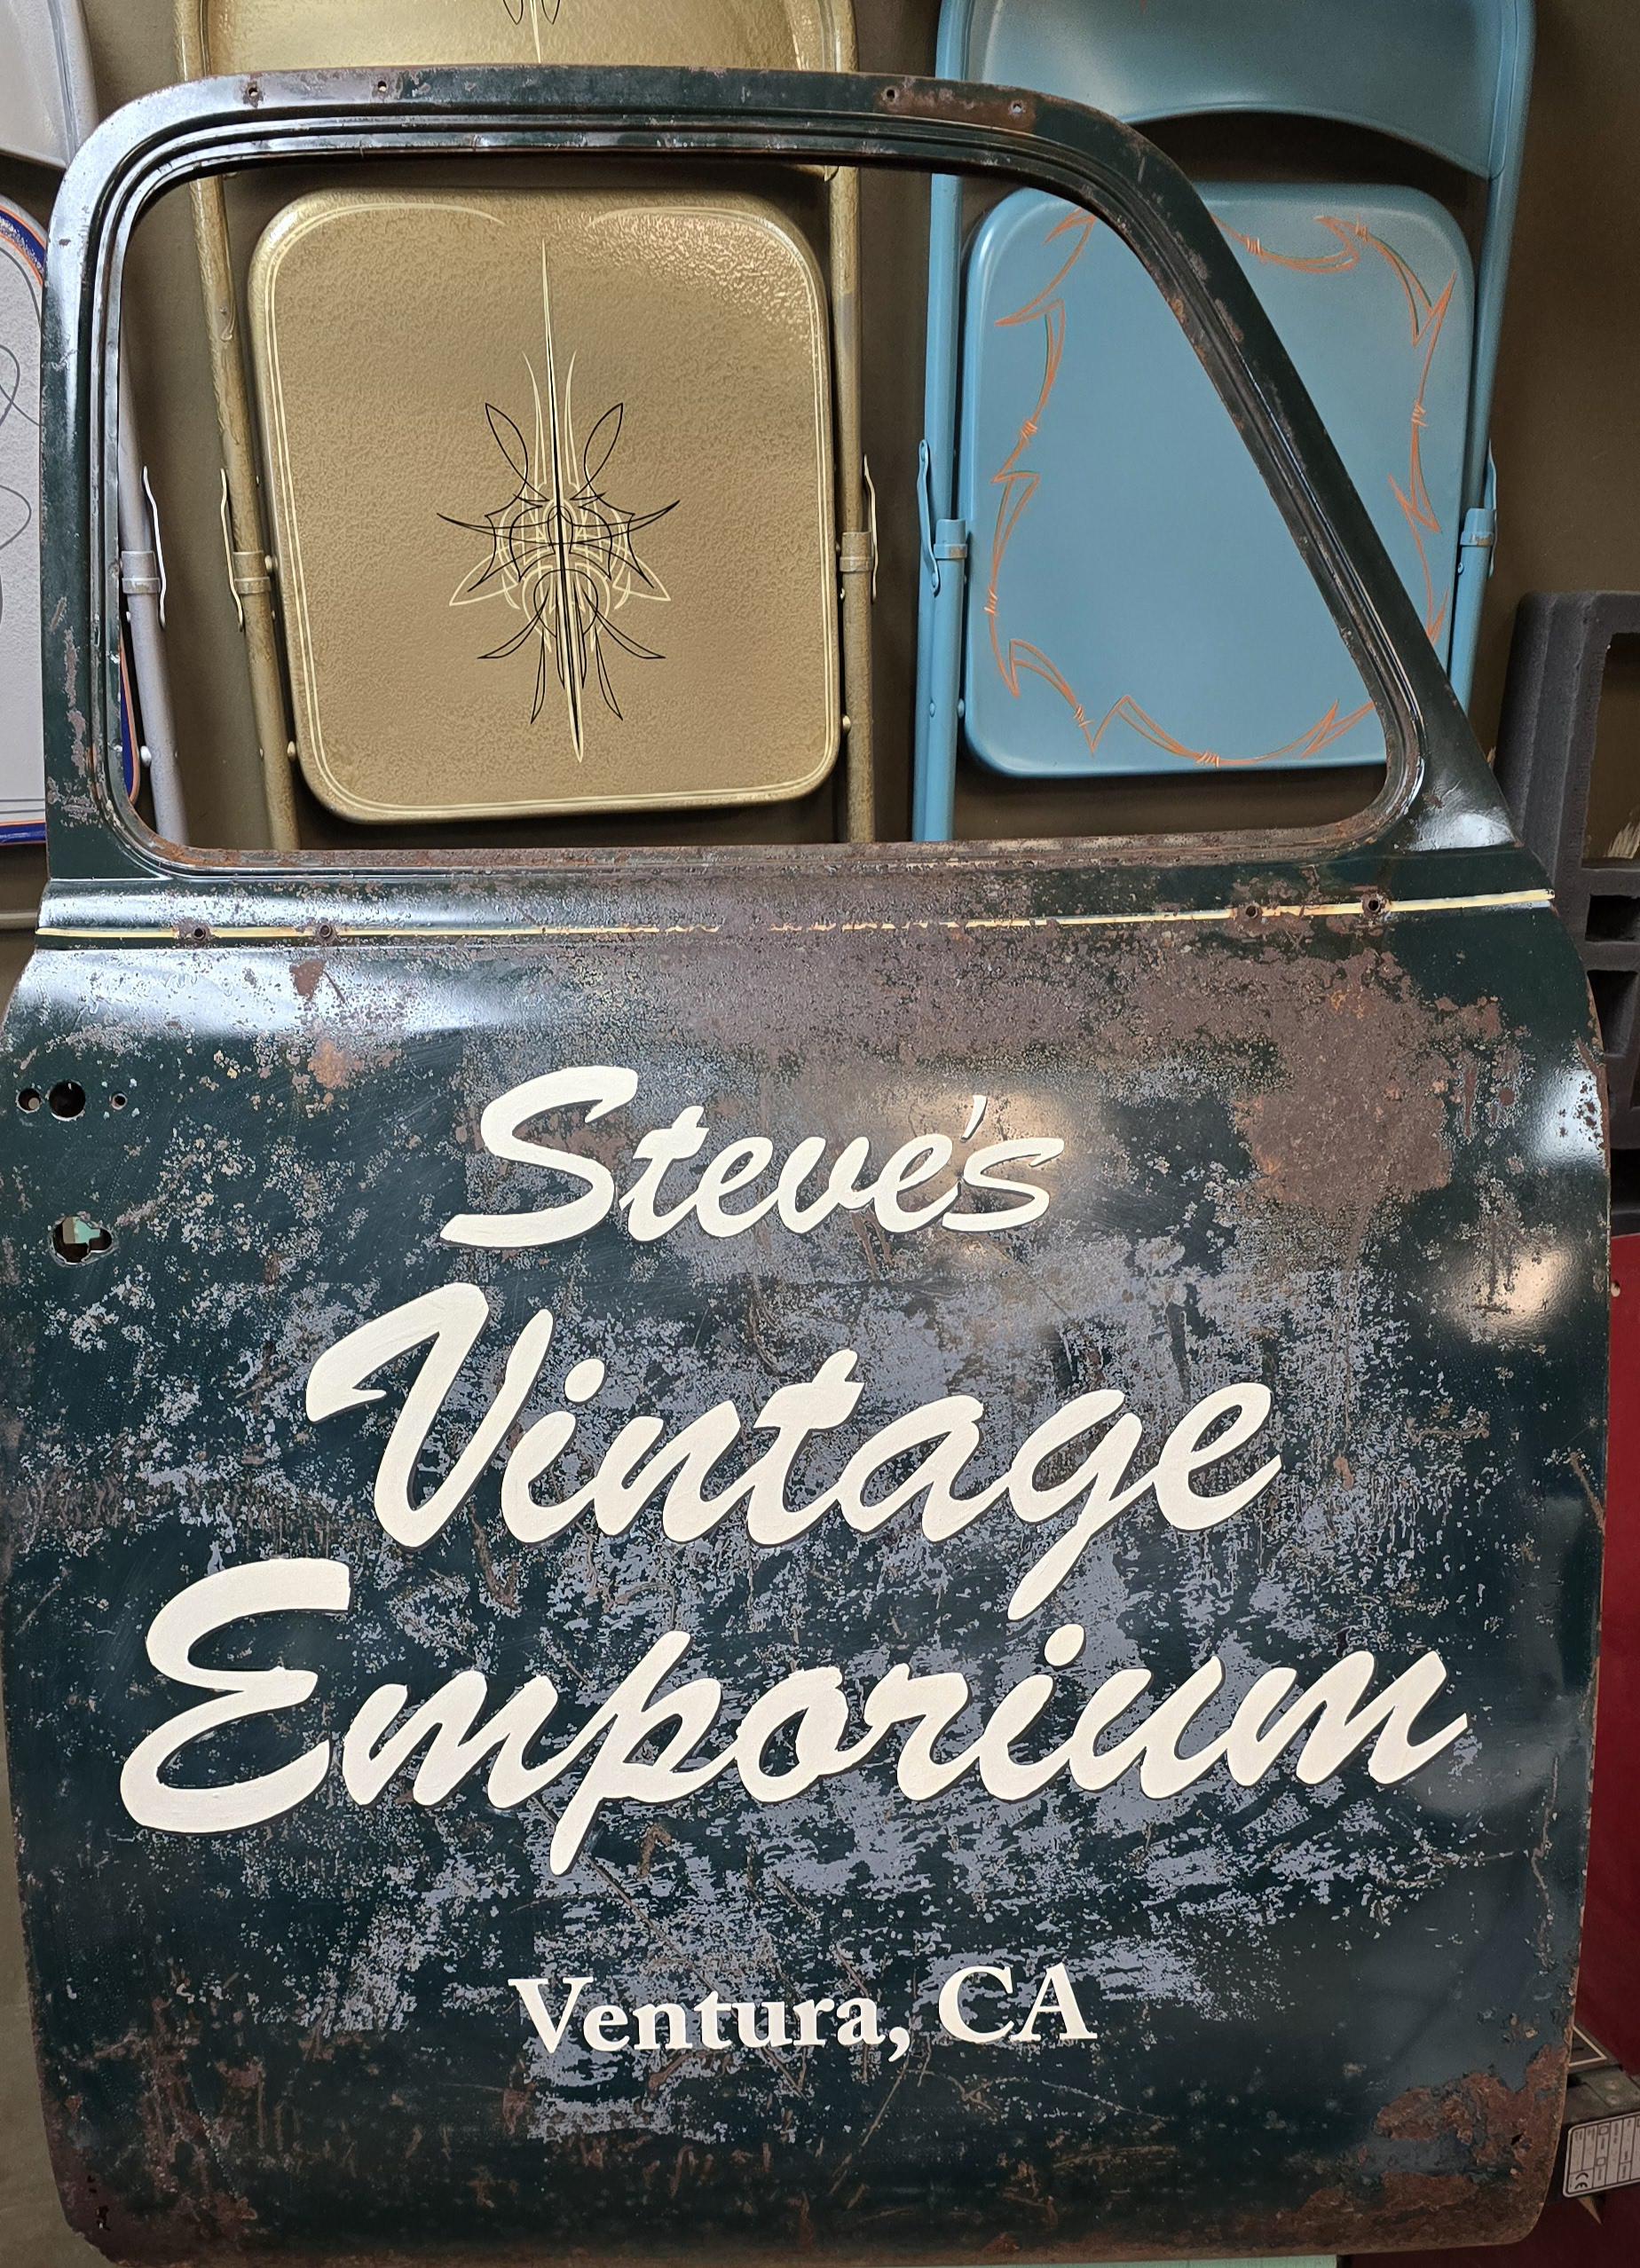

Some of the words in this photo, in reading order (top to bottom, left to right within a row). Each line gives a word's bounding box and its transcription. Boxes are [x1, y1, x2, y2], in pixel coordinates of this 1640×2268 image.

[438, 1064, 1065, 1248] Steve's
[304, 1281, 1283, 1621] Vintage
[120, 1557, 1469, 1877] Emporium
[508, 1976, 911, 2062] Ventura,
[938, 1962, 1098, 2044] CA
